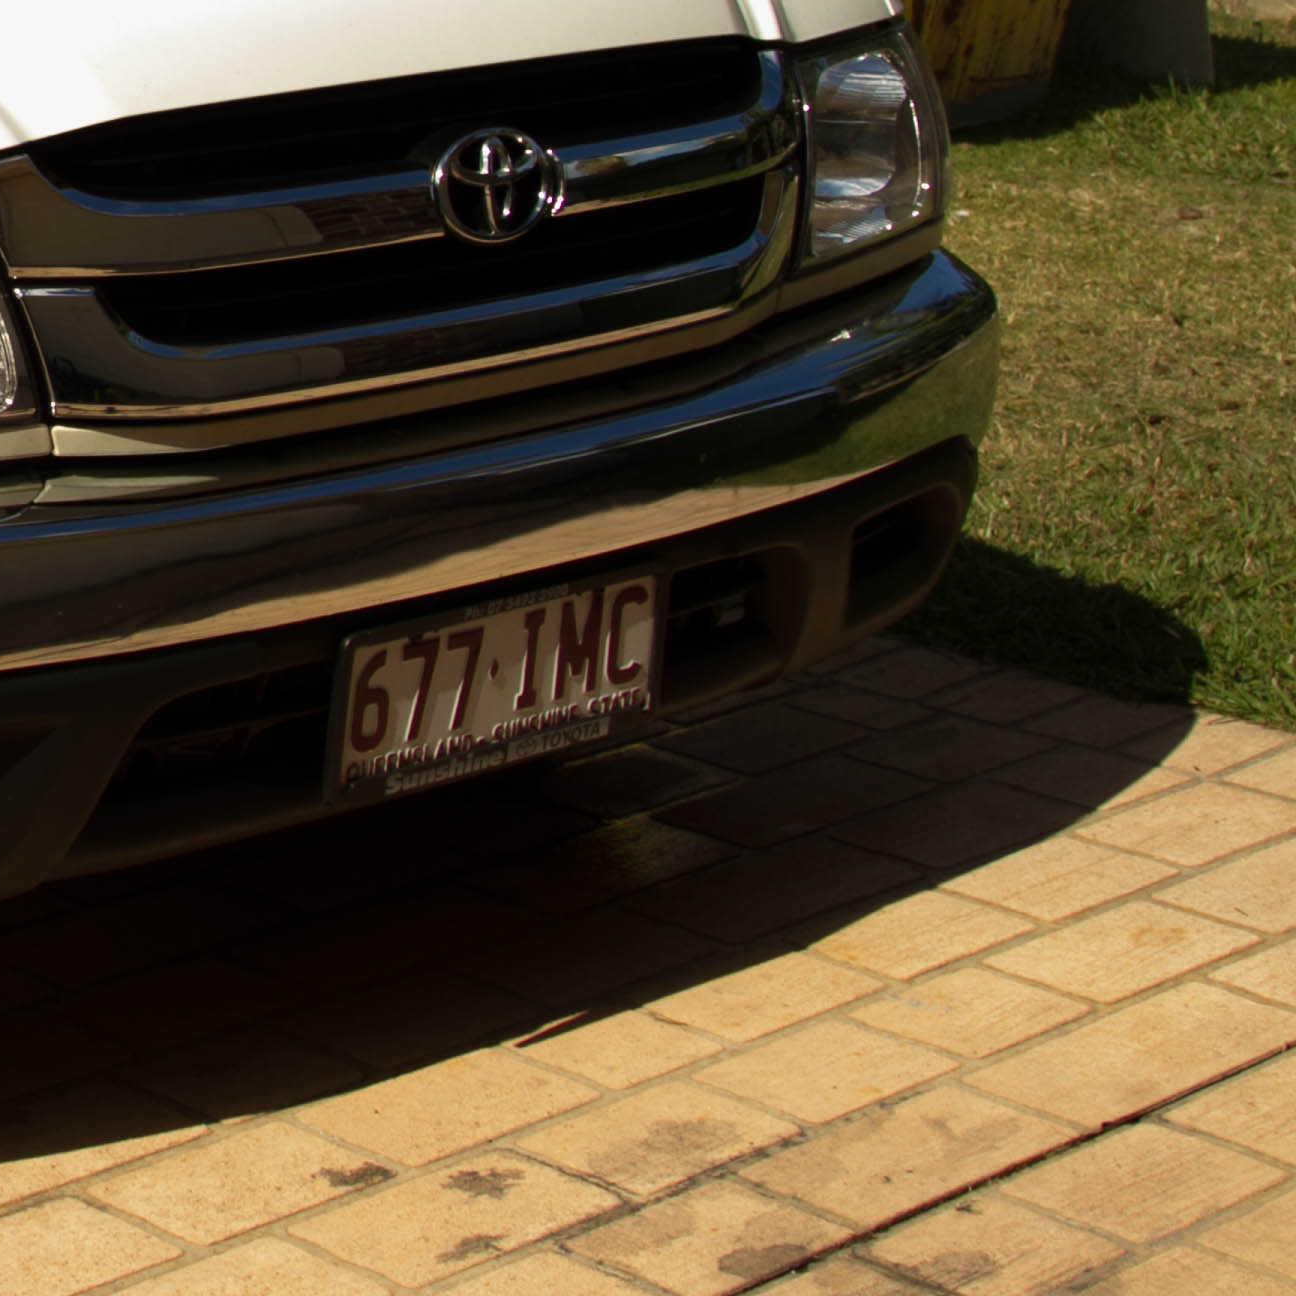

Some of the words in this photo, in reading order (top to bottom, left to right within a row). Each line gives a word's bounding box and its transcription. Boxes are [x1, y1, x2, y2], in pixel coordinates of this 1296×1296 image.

[346, 733, 473, 781] QUEENSLAND
[490, 701, 578, 743] SUNSHINE
[586, 687, 642, 716] STATE
[385, 746, 507, 796] Sunshine
[540, 721, 602, 751] TOYOTA
